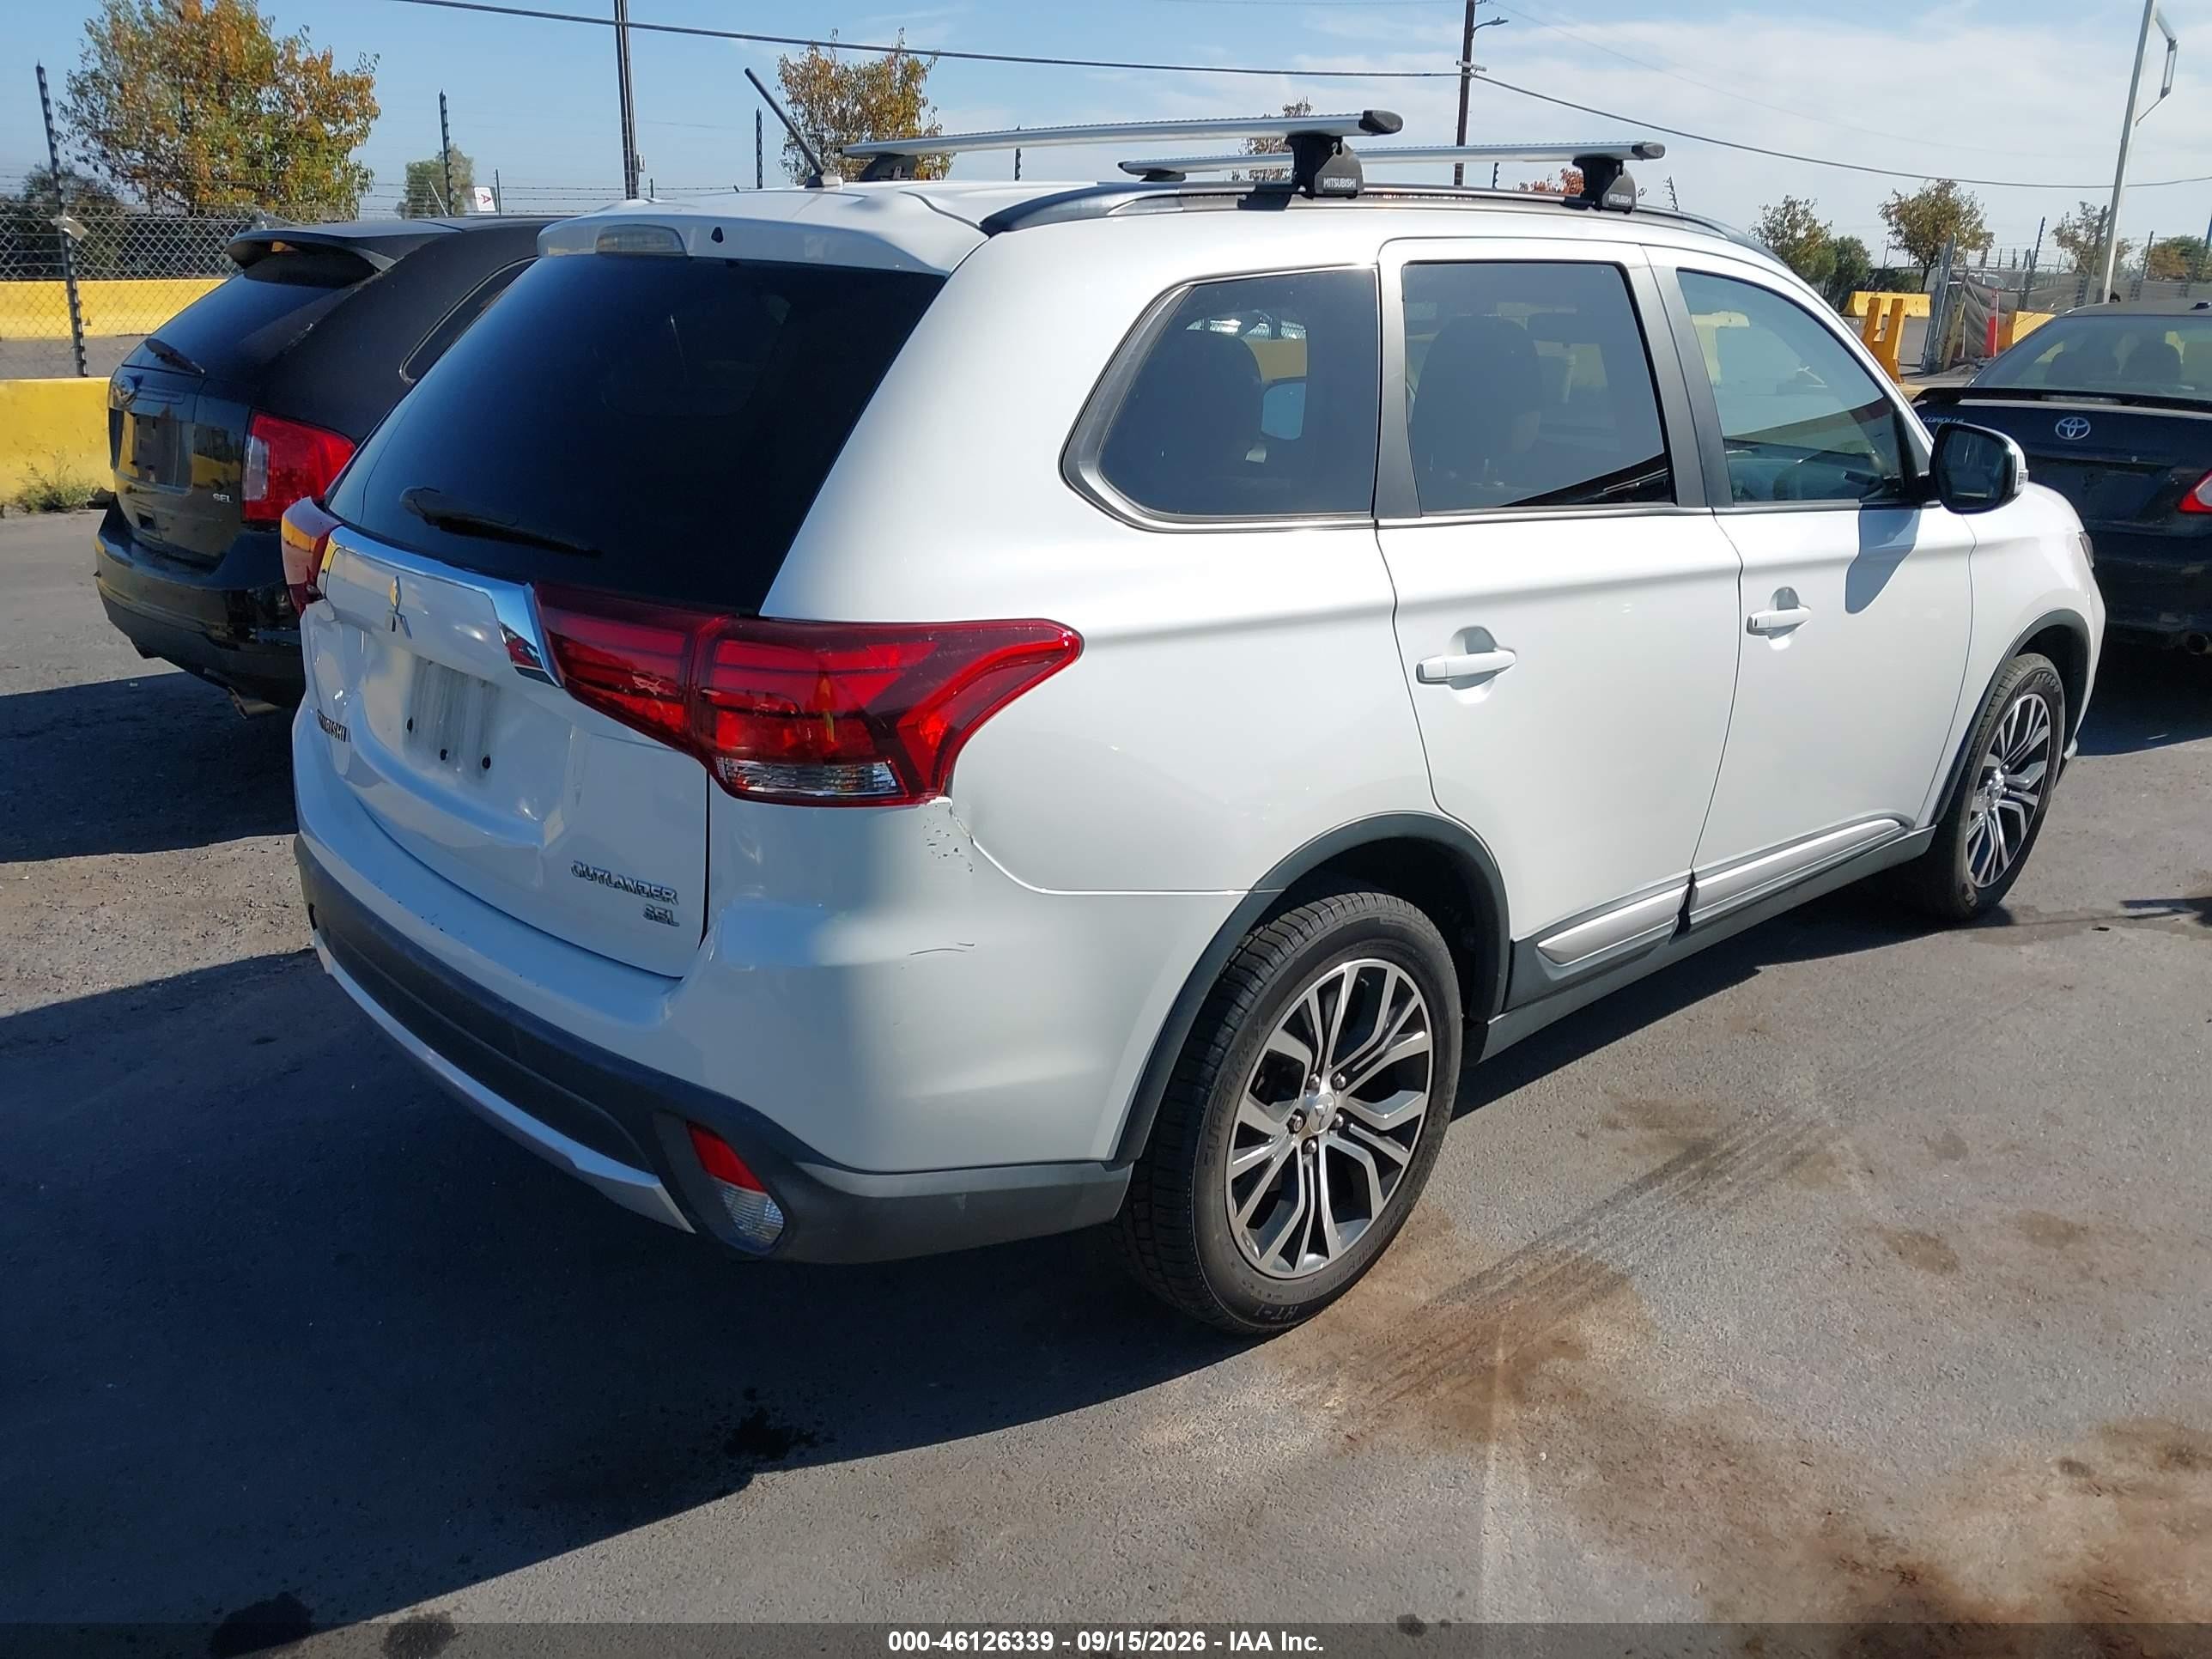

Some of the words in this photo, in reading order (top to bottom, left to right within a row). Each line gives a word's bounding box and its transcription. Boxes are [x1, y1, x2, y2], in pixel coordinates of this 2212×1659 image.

[1322, 177, 1357, 188] MITSUBISHI
[569, 860, 679, 906] OUTLANDER
[642, 903, 681, 927] SEL
